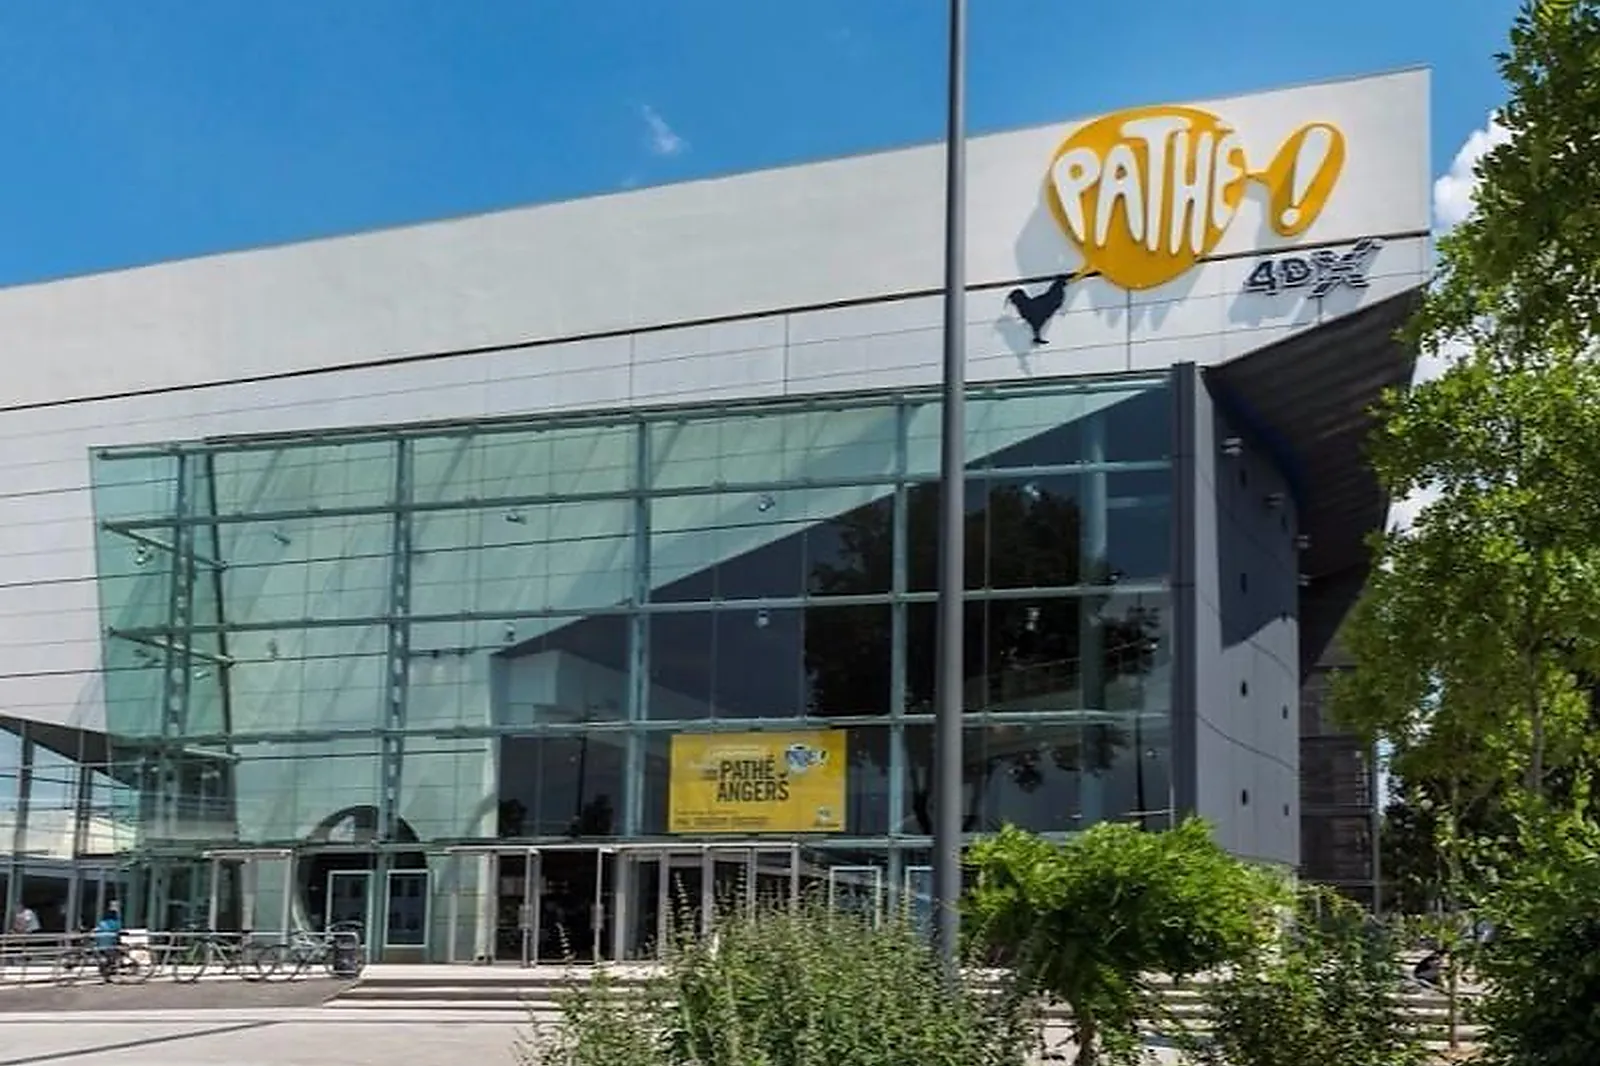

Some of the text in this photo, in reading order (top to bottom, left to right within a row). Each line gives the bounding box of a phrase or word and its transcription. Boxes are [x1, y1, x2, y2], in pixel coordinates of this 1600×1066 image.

[1243, 237, 1382, 300] 4DX
[720, 754, 776, 779] PATHÉ
[716, 780, 790, 802] ANGERS
